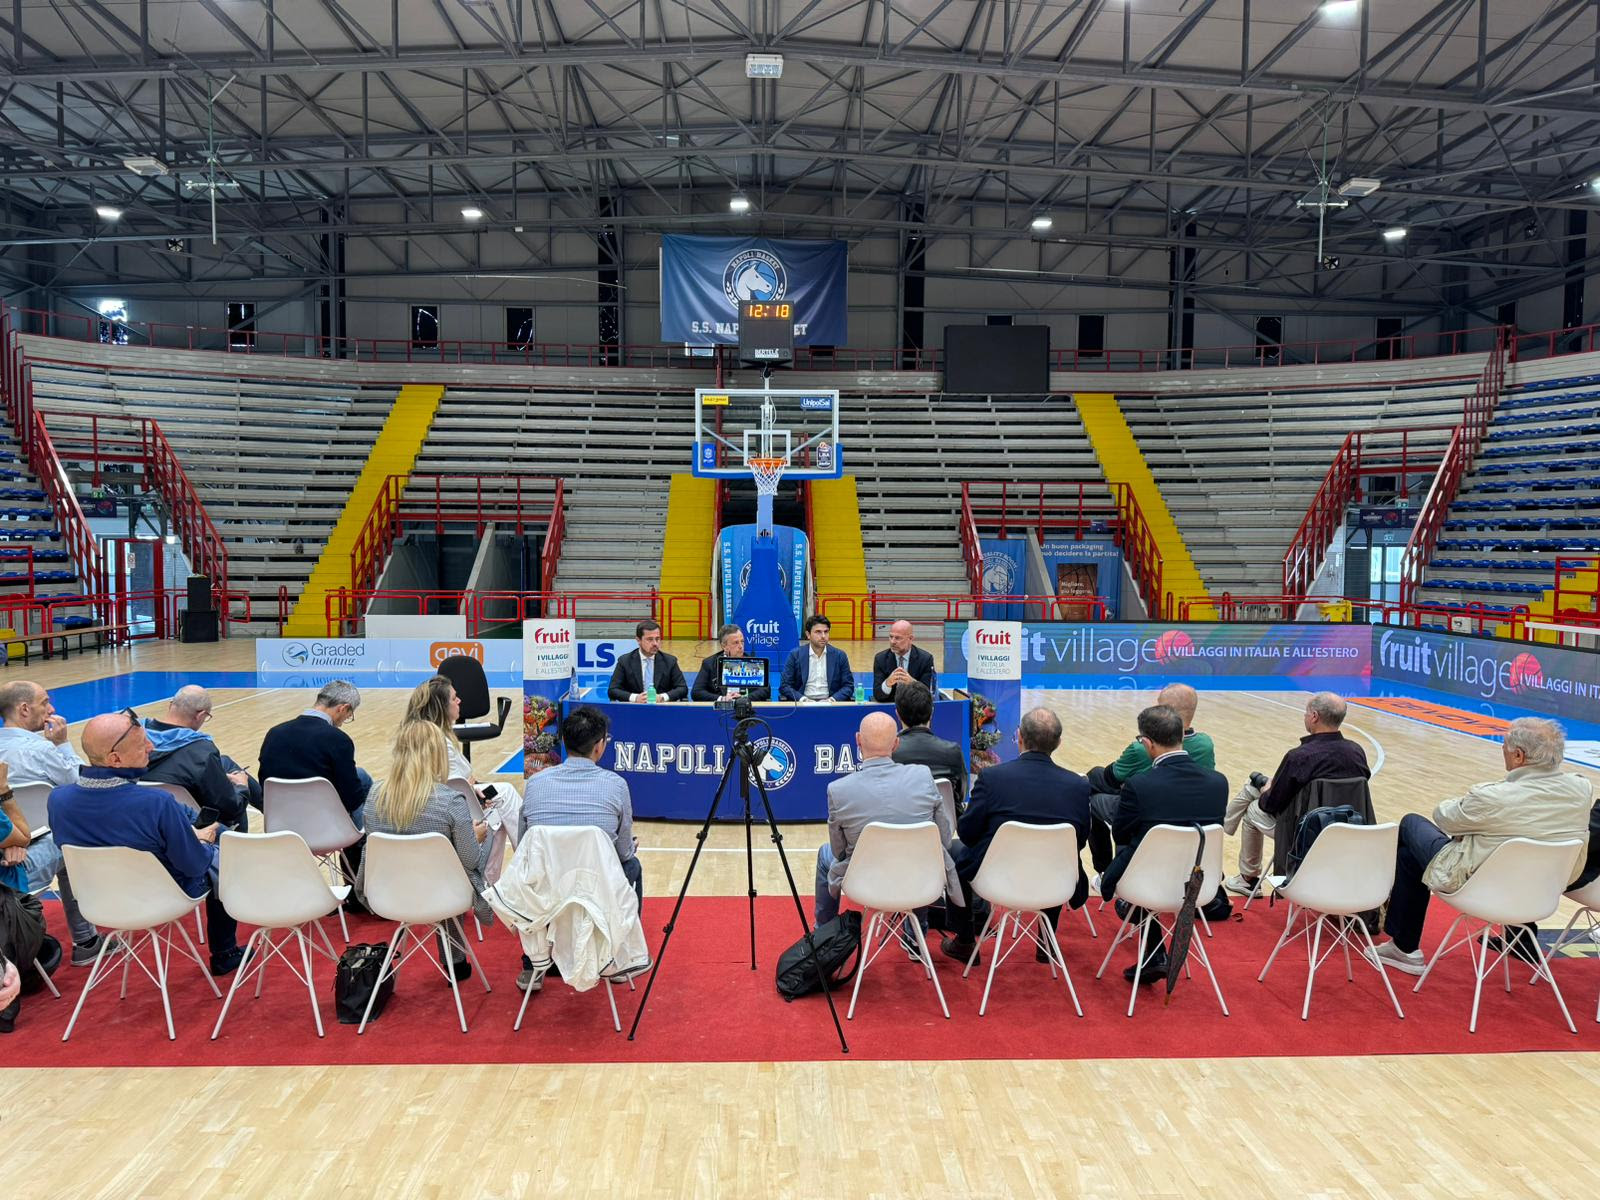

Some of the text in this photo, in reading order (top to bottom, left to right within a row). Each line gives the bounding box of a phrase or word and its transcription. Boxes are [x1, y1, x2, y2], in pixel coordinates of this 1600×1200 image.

[731, 251, 780, 269] NAPOLI BASKET
[749, 304, 789, 318] 12:18
[692, 321, 739, 335] S.S. NAP
[723, 558, 732, 586] NAPOLI
[794, 560, 802, 589] NAPOLI
[724, 588, 732, 617] BASKET
[793, 590, 801, 619] BASKET
[311, 642, 365, 656] Graded
[746, 634, 780, 647] village
[1050, 628, 1157, 672] village
[1167, 646, 1171, 657] I
[1172, 646, 1226, 657] VILLAGGI
[1229, 646, 1242, 657] IN
[1244, 647, 1281, 658] ITALIA
[1283, 647, 1290, 658] E
[311, 657, 356, 667] holding
[1433, 642, 1512, 698] village
[1524, 673, 1572, 694] VILLAGGI
[1575, 681, 1587, 697] IN
[614, 741, 725, 774] NAPOLI
